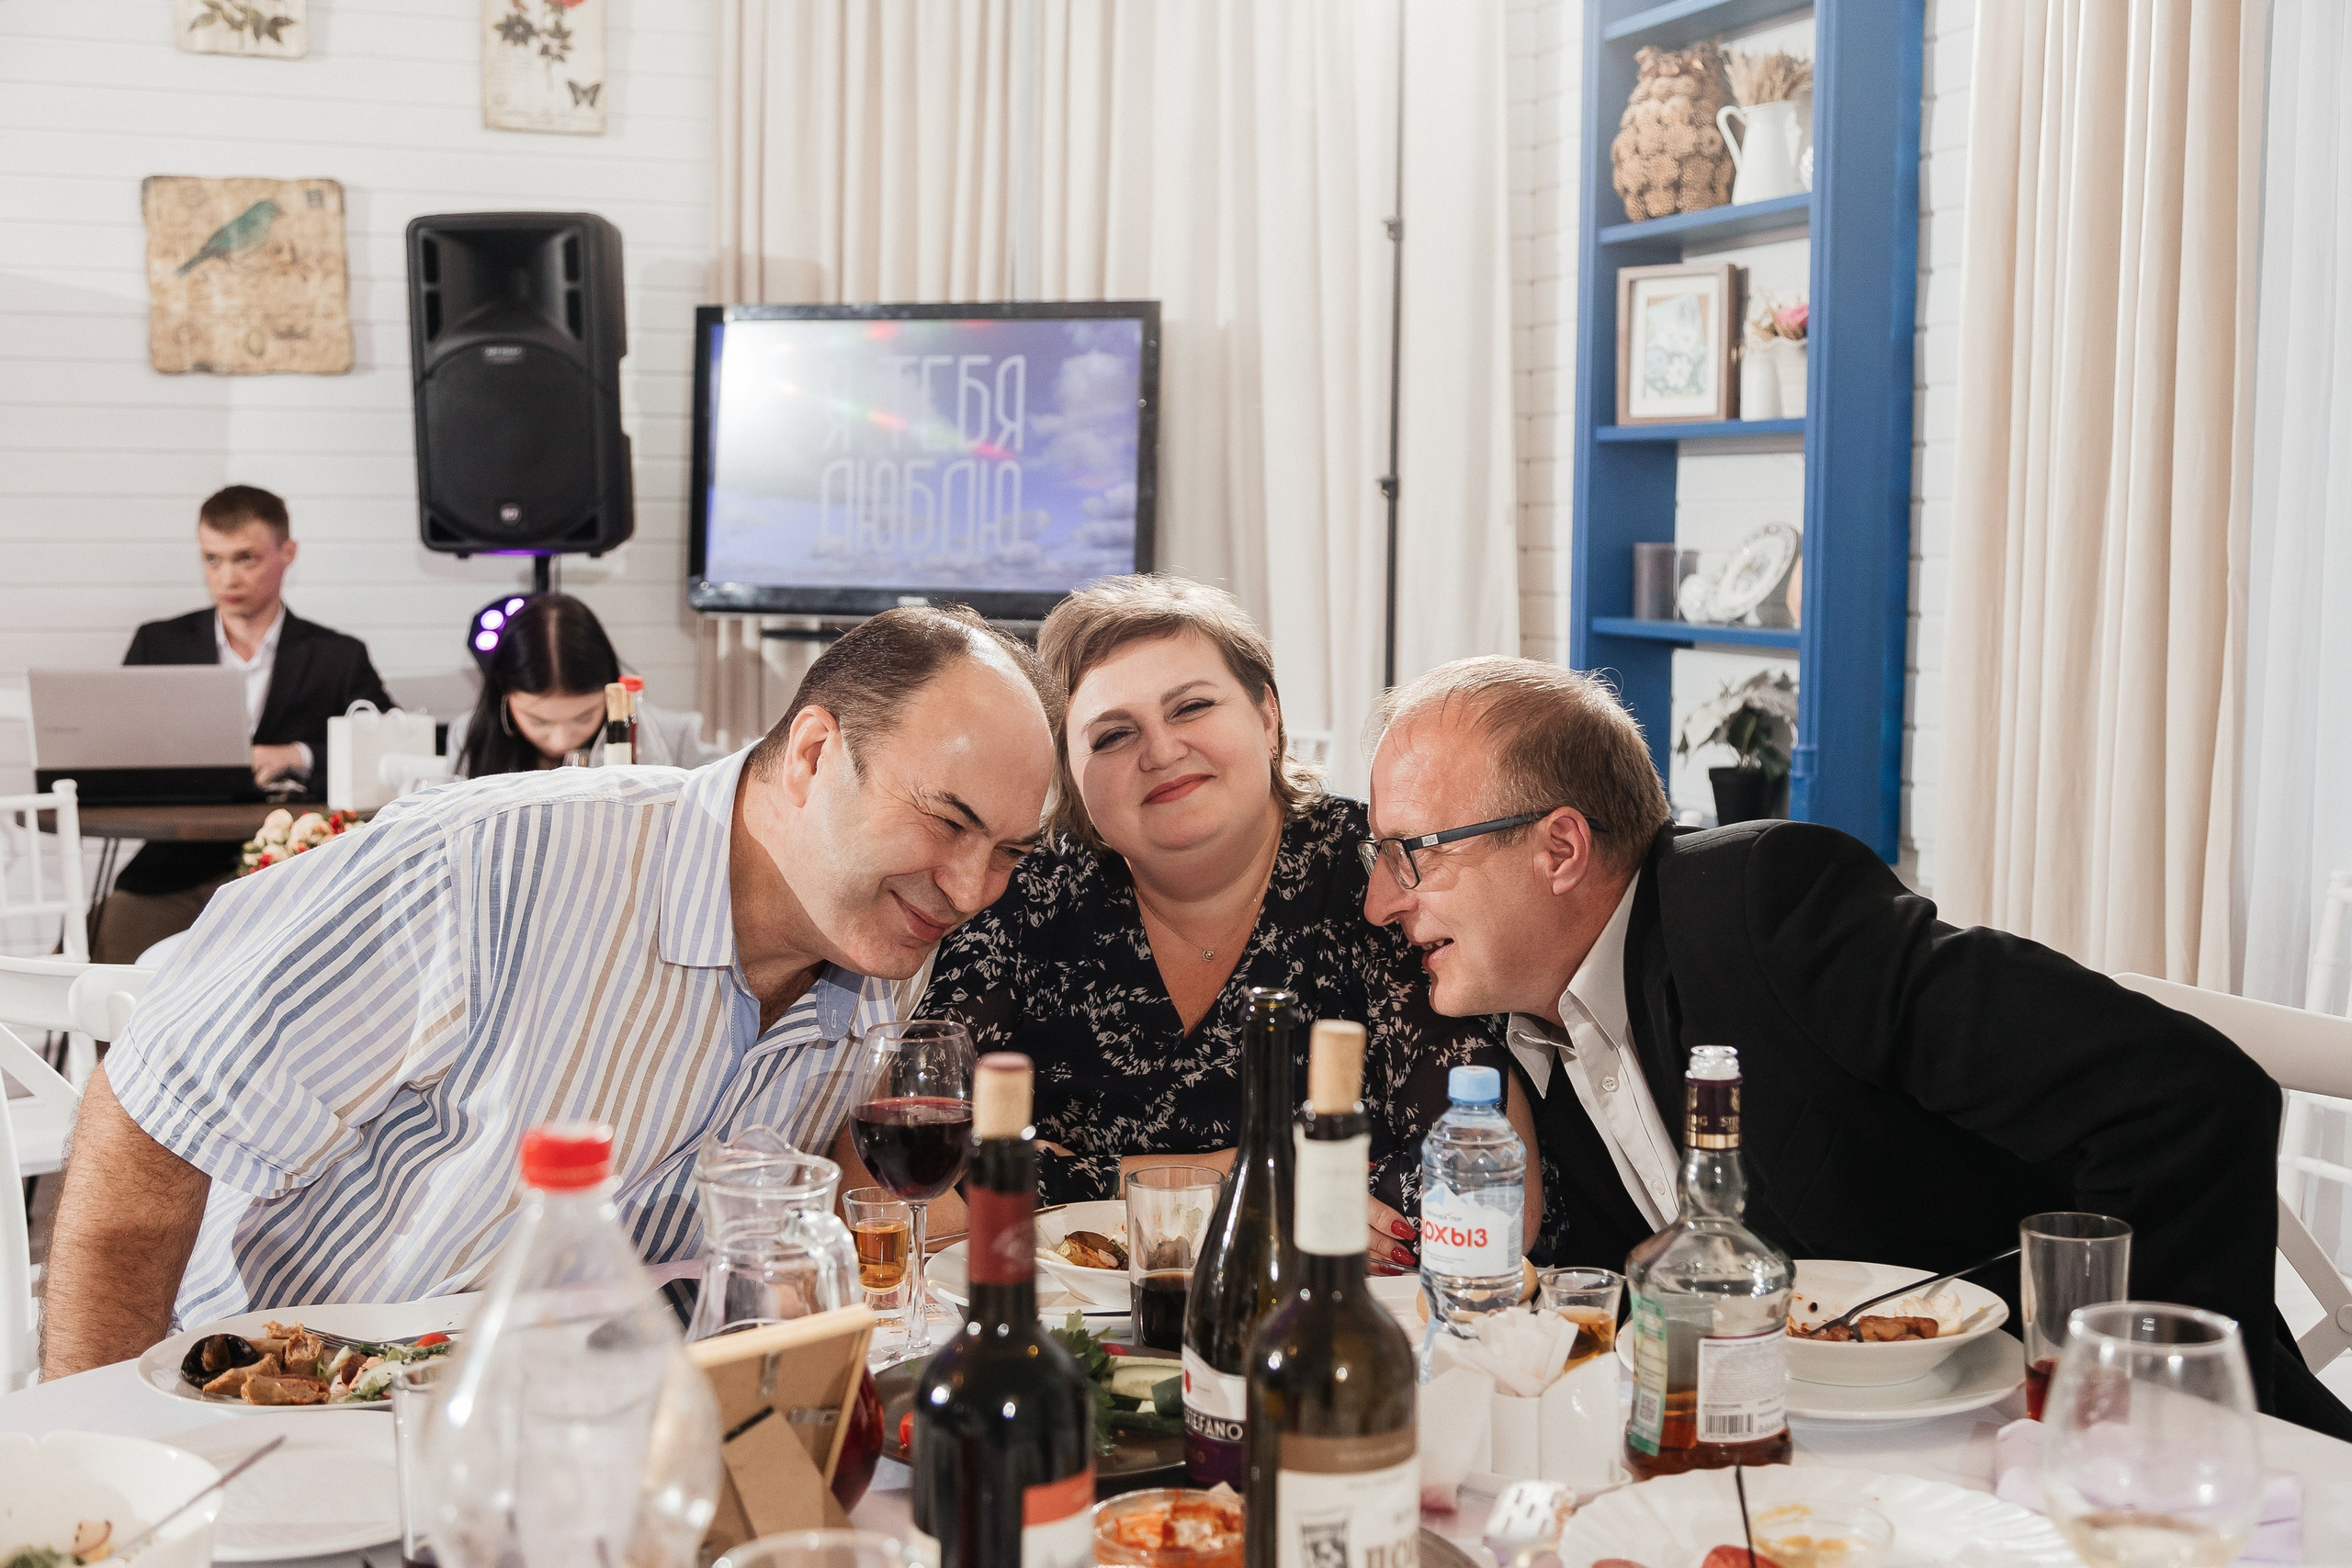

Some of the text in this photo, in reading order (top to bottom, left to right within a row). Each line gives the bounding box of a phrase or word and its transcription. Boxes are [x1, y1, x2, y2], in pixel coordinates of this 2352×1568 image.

[822, 355, 1026, 452] Я ТЕБЯ
[820, 458, 1023, 554] ЛЮБЛЮ
[1184, 1407, 1244, 1441] STEFANO
